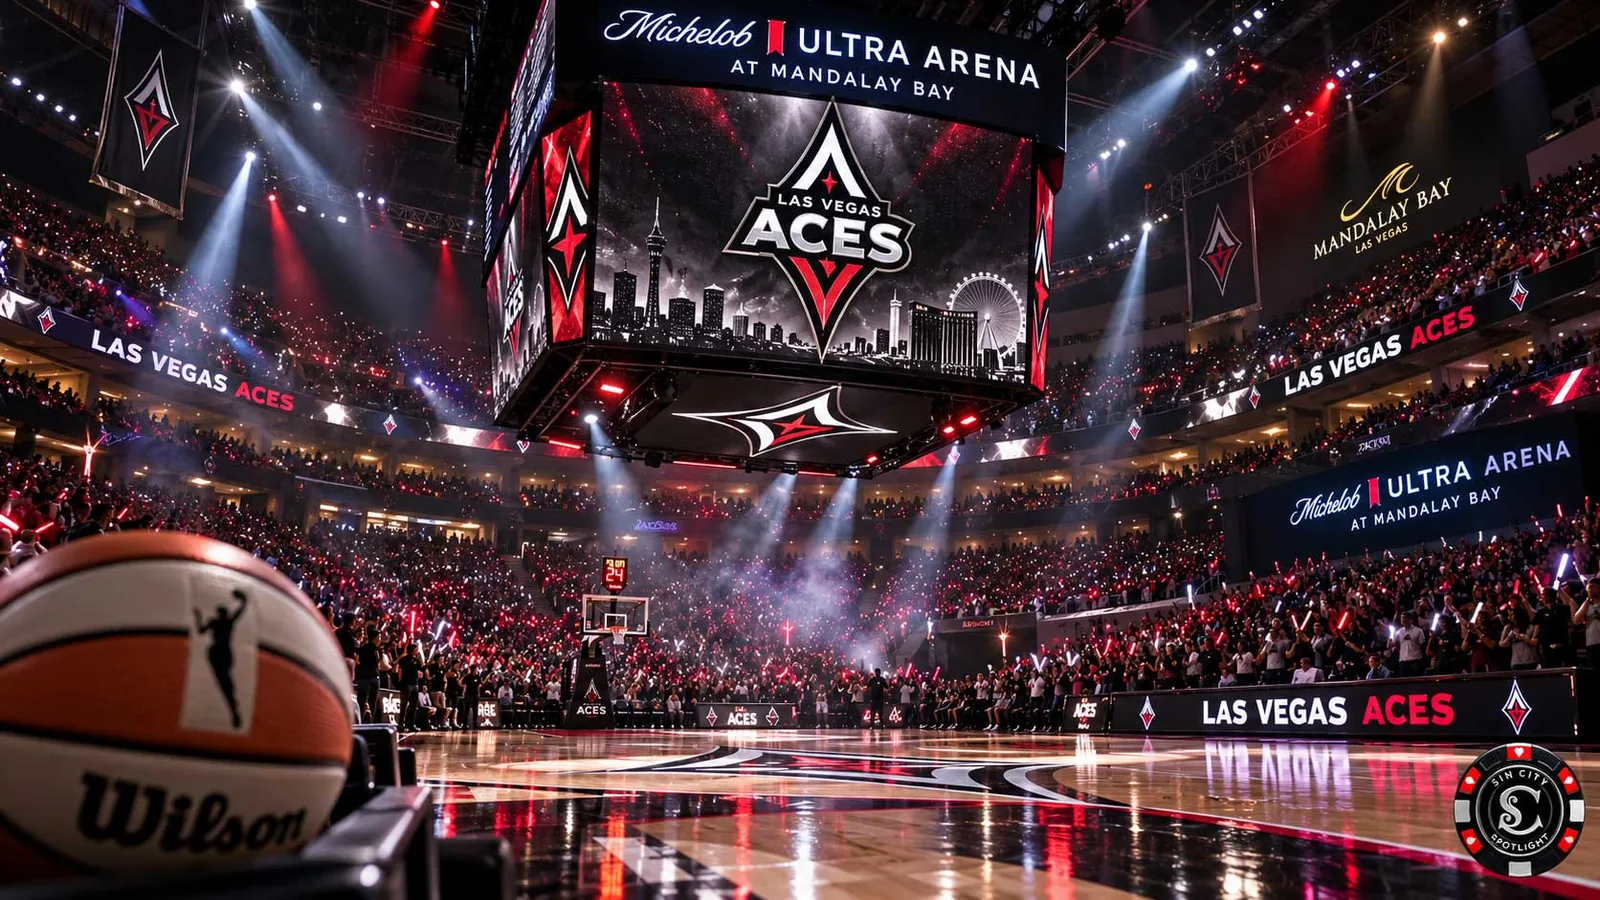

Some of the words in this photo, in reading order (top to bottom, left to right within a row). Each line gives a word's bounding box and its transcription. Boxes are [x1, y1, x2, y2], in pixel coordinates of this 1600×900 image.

[604, 9, 756, 47] Michelob
[799, 27, 910, 65] ULTRA
[923, 45, 1040, 89] ARENA
[730, 59, 758, 75] AT
[771, 63, 901, 93] MANDALAY
[913, 80, 954, 101] BAY
[777, 193, 813, 208] LAS
[821, 198, 882, 218] VEGAS
[1313, 198, 1409, 260] MANDALAY
[1416, 177, 1452, 209] BAY
[741, 207, 903, 264] ACES
[1355, 239, 1373, 254] LAS
[1375, 222, 1408, 244] VEGAS
[91, 328, 143, 364] LAS
[151, 350, 228, 393] VEGAS
[235, 381, 295, 412] ACES
[1284, 364, 1324, 396] LAS
[1328, 334, 1402, 378] VEGAS
[1410, 305, 1475, 350] ACES
[1290, 484, 1362, 526] Michelob
[1387, 460, 1472, 498] ULTRA
[1484, 440, 1571, 476] ARENA
[1350, 515, 1367, 531] AT
[1373, 495, 1461, 526] MANDALAY
[1469, 485, 1501, 505] BAY
[606, 566, 624, 582] 24
[576, 705, 607, 715] ACES
[727, 712, 757, 726] ACES
[1202, 699, 1248, 725] LAS
[1255, 696, 1348, 725] VEGAS
[1362, 692, 1455, 726] ACES
[77, 771, 308, 853] Wilson
